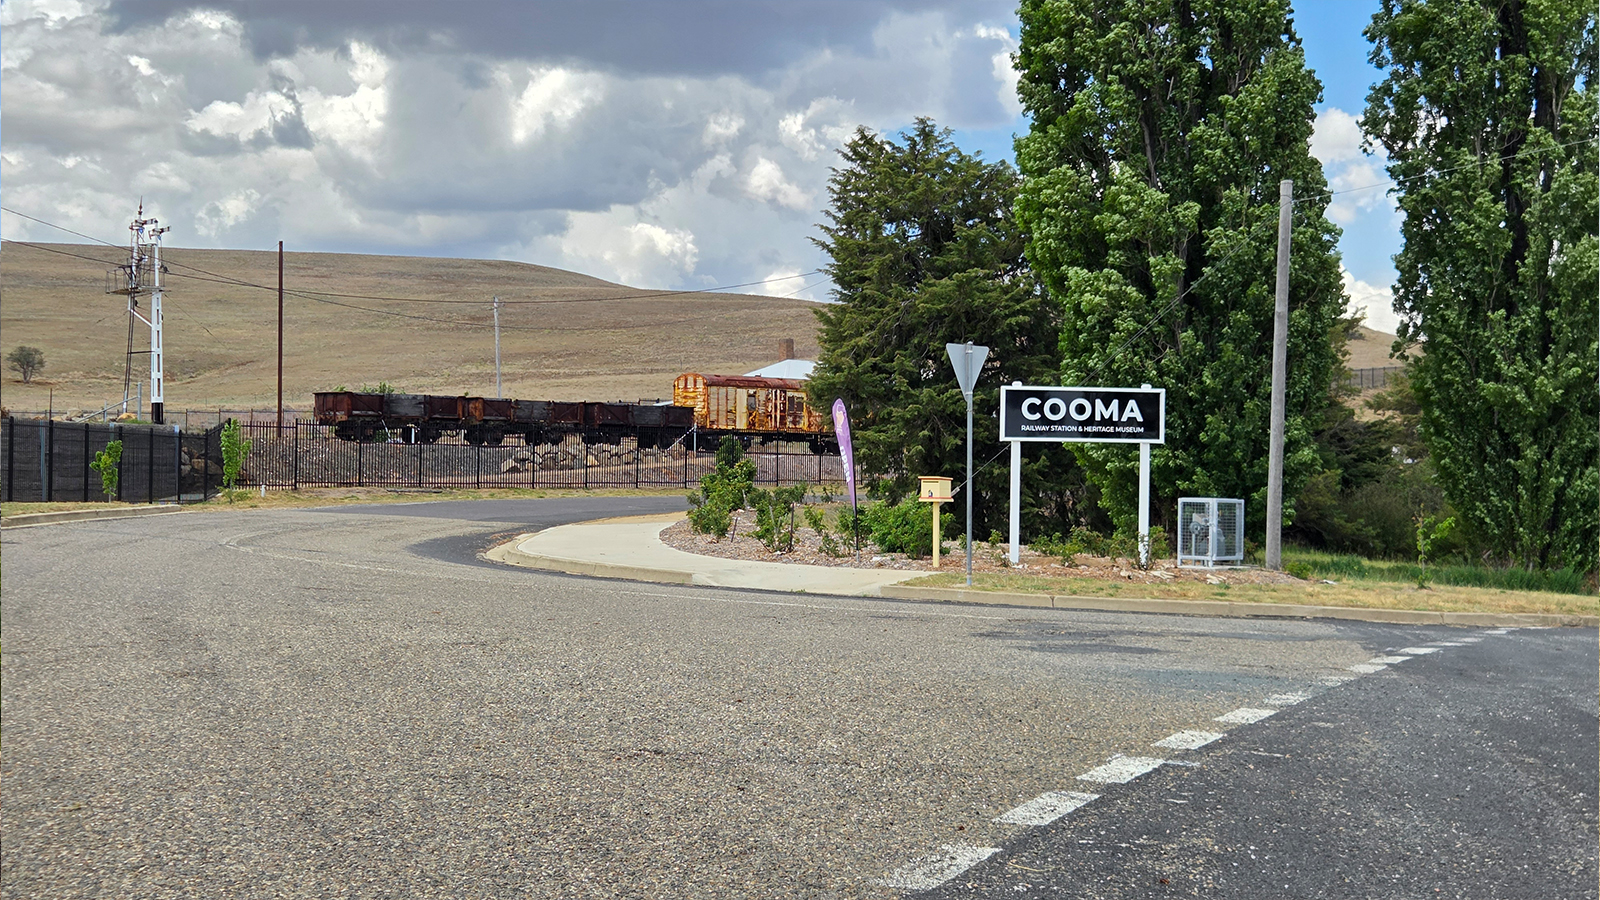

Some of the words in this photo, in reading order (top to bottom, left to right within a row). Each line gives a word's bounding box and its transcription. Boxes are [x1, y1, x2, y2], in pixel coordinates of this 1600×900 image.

[1021, 397, 1144, 422] COOMA
[1084, 425, 1115, 433] HERITAGE
[840, 446, 851, 482] OPEN
